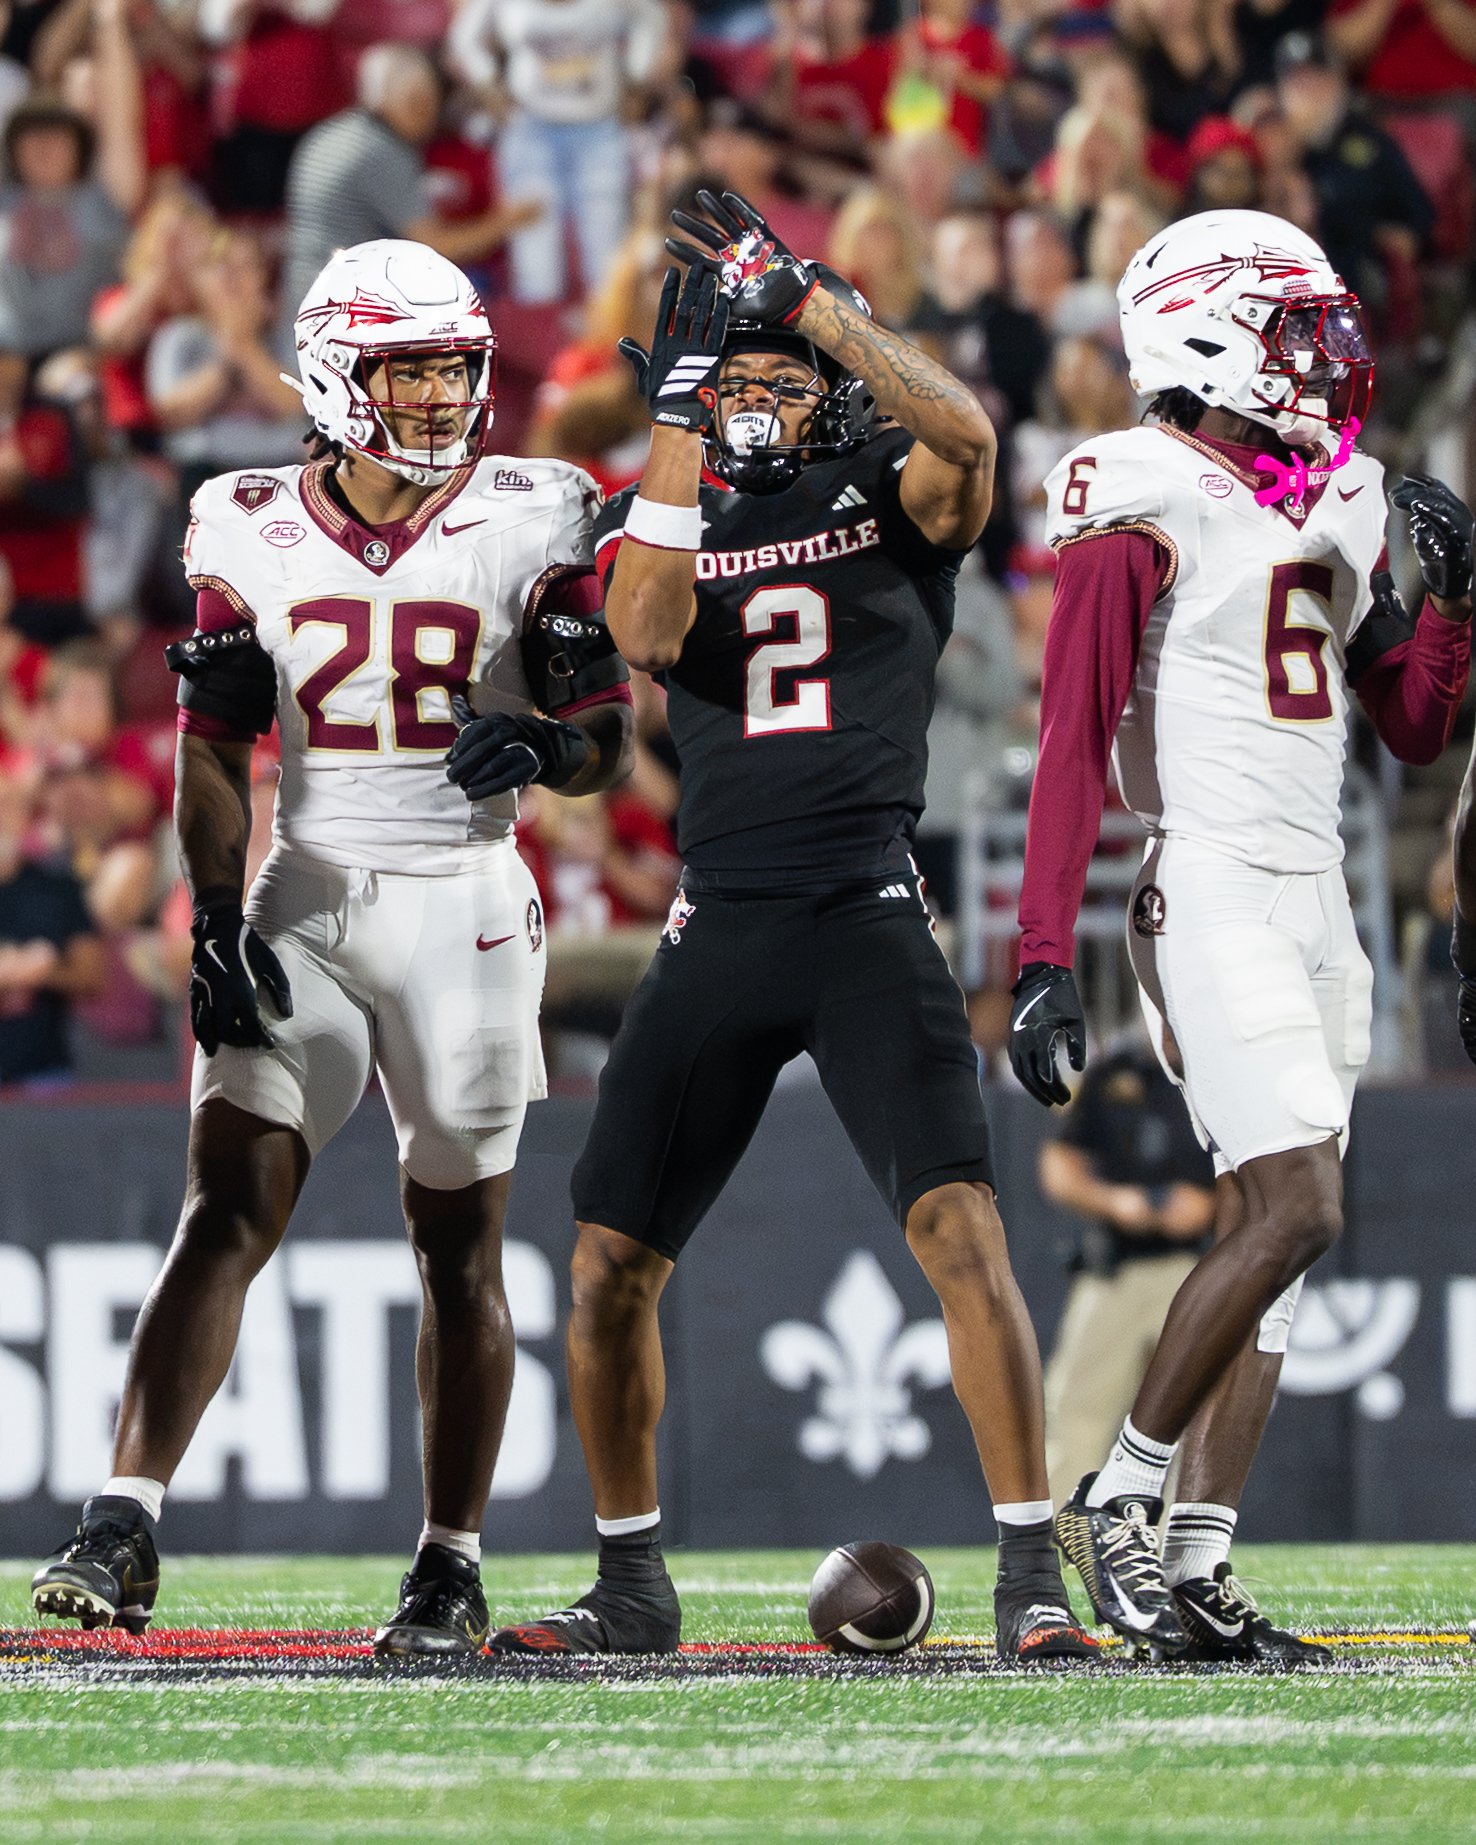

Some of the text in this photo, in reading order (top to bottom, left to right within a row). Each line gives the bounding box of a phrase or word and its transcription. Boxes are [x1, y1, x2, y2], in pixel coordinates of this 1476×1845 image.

[656, 412, 691, 426] ADIZERO
[1062, 455, 1098, 516] 6
[266, 526, 300, 538] ACC
[695, 518, 880, 581] OUISVILLE
[740, 583, 832, 739] 2
[1262, 557, 1335, 725] 6
[287, 594, 485, 755] 28
